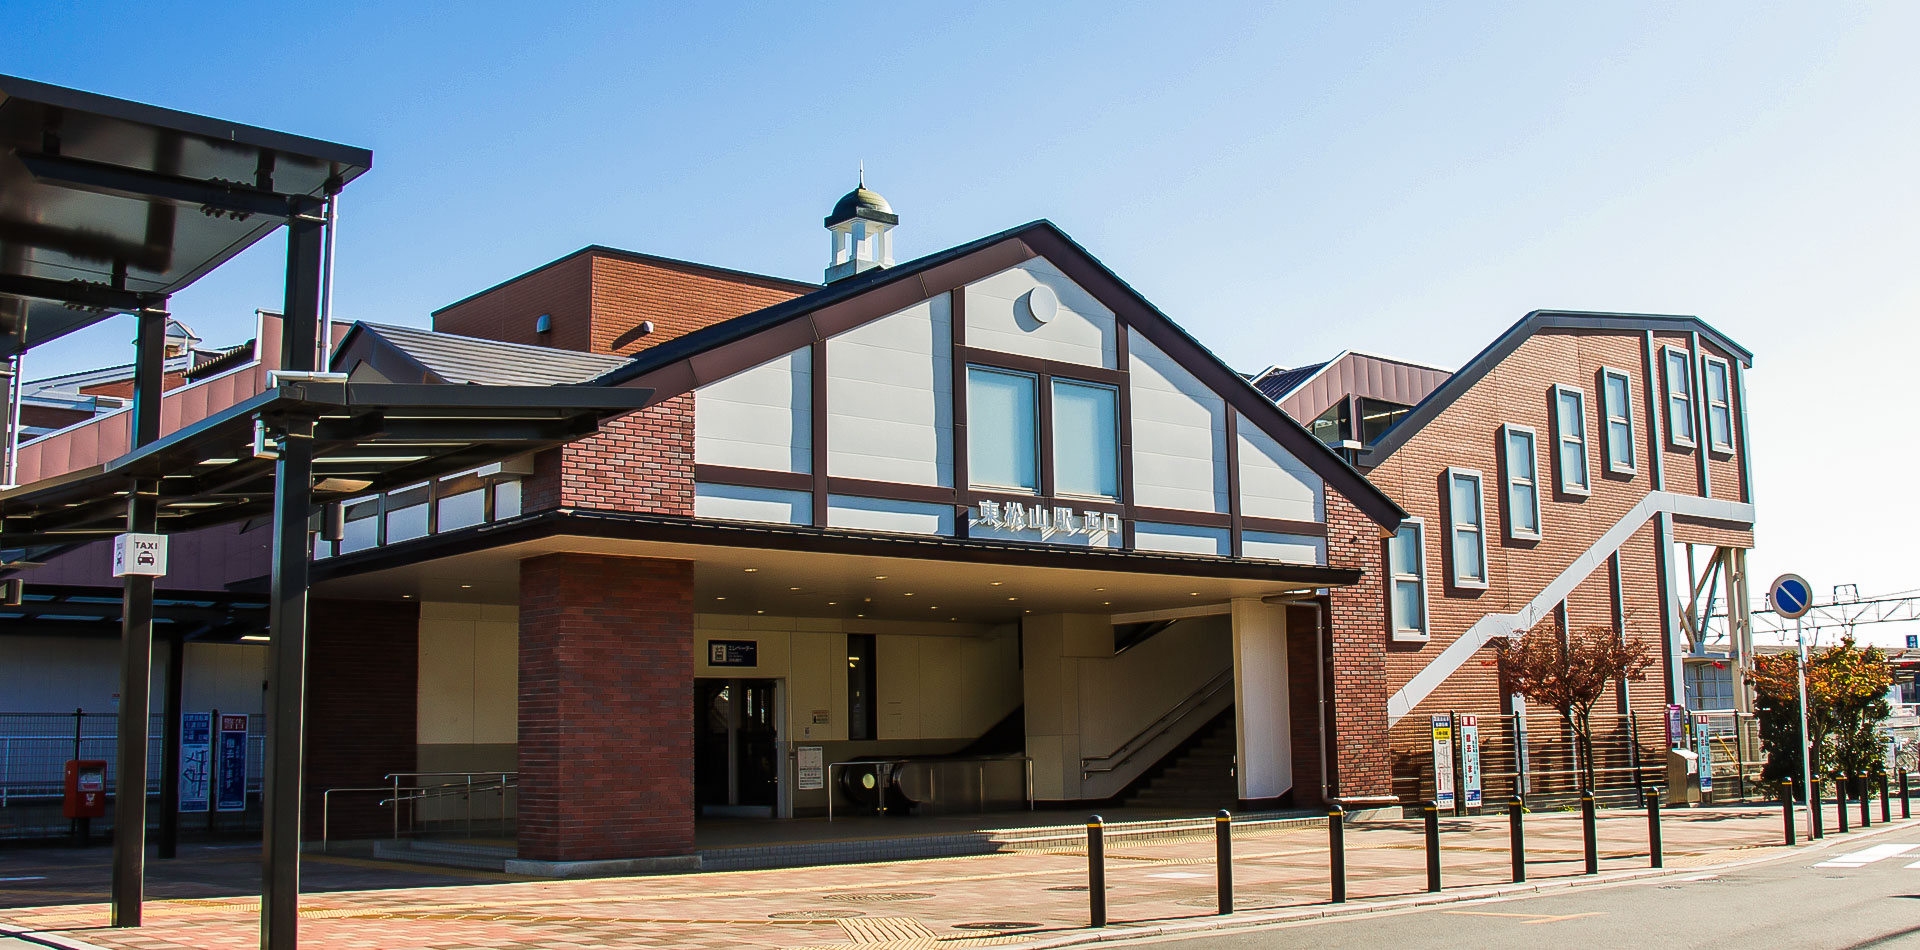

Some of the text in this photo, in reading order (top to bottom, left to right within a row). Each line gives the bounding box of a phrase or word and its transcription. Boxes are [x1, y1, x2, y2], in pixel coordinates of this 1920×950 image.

[978, 499, 1119, 533] 東松山駅 西口
[135, 541, 158, 550] TAXI
[223, 717, 245, 730] 警告
